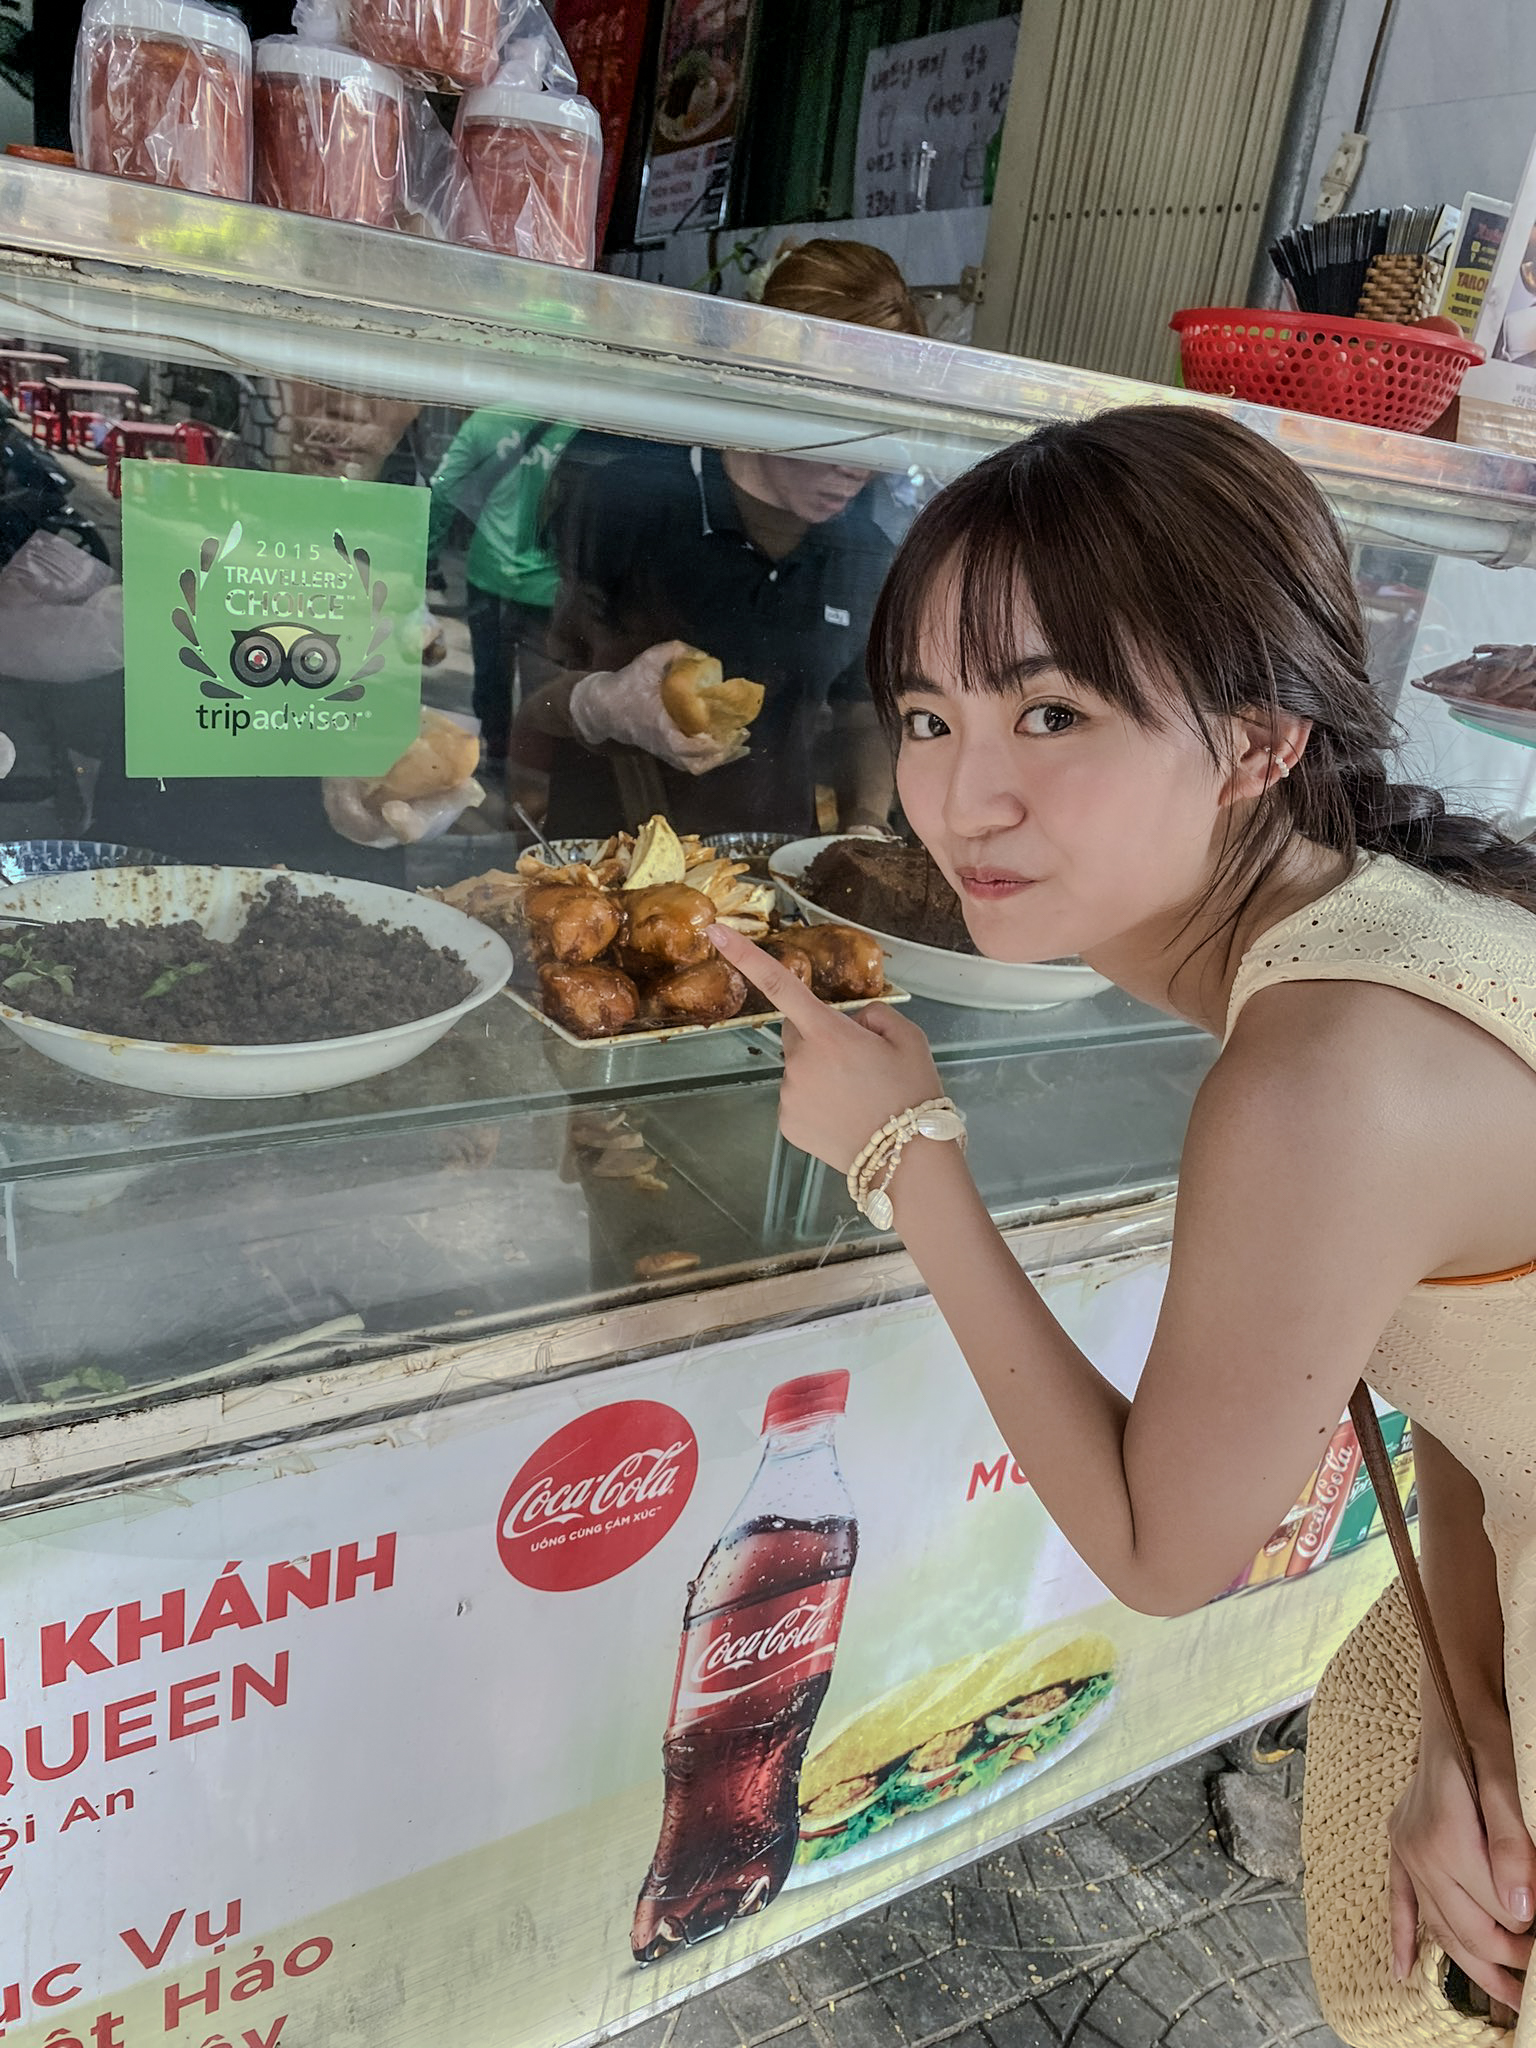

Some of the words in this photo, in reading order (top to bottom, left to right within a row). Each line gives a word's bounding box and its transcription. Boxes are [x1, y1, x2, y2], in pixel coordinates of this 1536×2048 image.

[223, 565, 353, 589] TRAVELLERS'
[256, 540, 320, 561] 2015
[224, 588, 344, 620] CHOICE
[195, 702, 363, 737] tripadvisor
[502, 1438, 693, 1540] Coca-Cola
[41, 1531, 397, 1688] KHÁNH
[690, 1595, 840, 1684] Coca-Cola
[0, 1650, 289, 1797] UEEN
[59, 1787, 135, 1833] An
[119, 1898, 242, 1971] Vụ
[164, 1936, 334, 2032] Hảo
